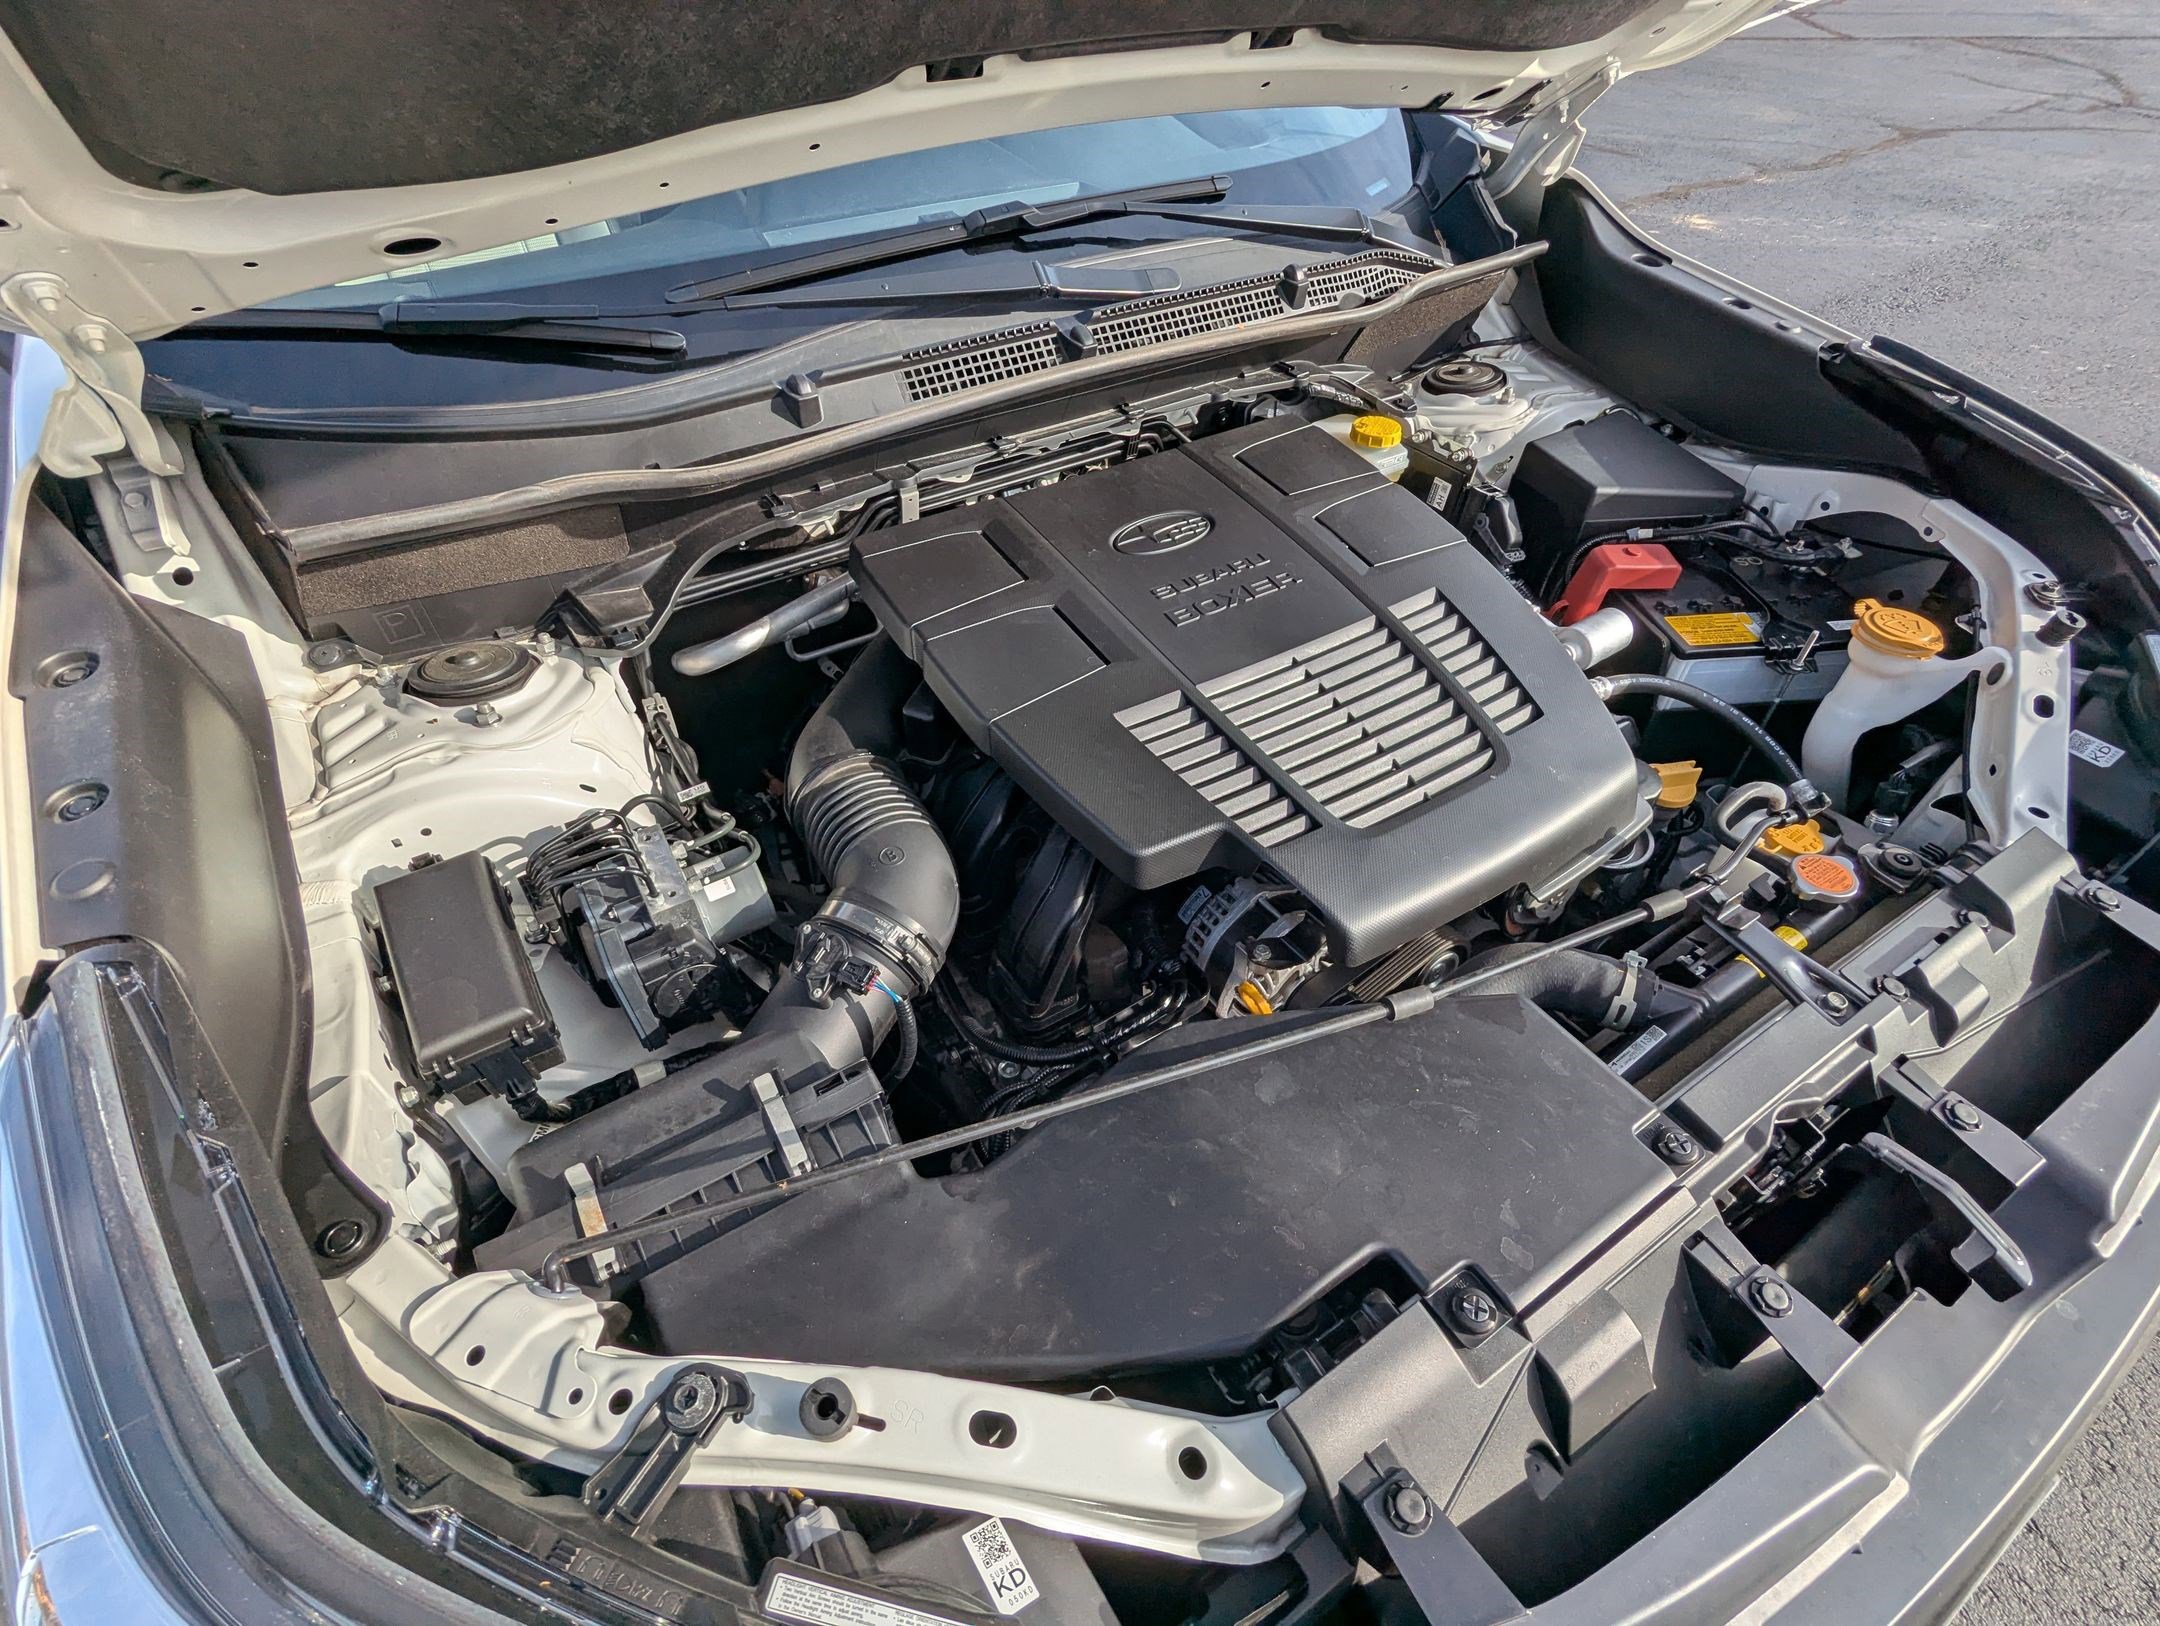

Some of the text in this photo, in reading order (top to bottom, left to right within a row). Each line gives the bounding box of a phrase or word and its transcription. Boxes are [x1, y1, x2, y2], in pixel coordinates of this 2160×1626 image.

[1150, 553, 1271, 600] SUBARU
[1164, 571, 1303, 627] BOXER
[2090, 745, 2111, 763] KD
[989, 1559, 1020, 1581] SUBARU
[992, 1567, 1027, 1598] KD
[1008, 1585, 1035, 1607] 050KD
